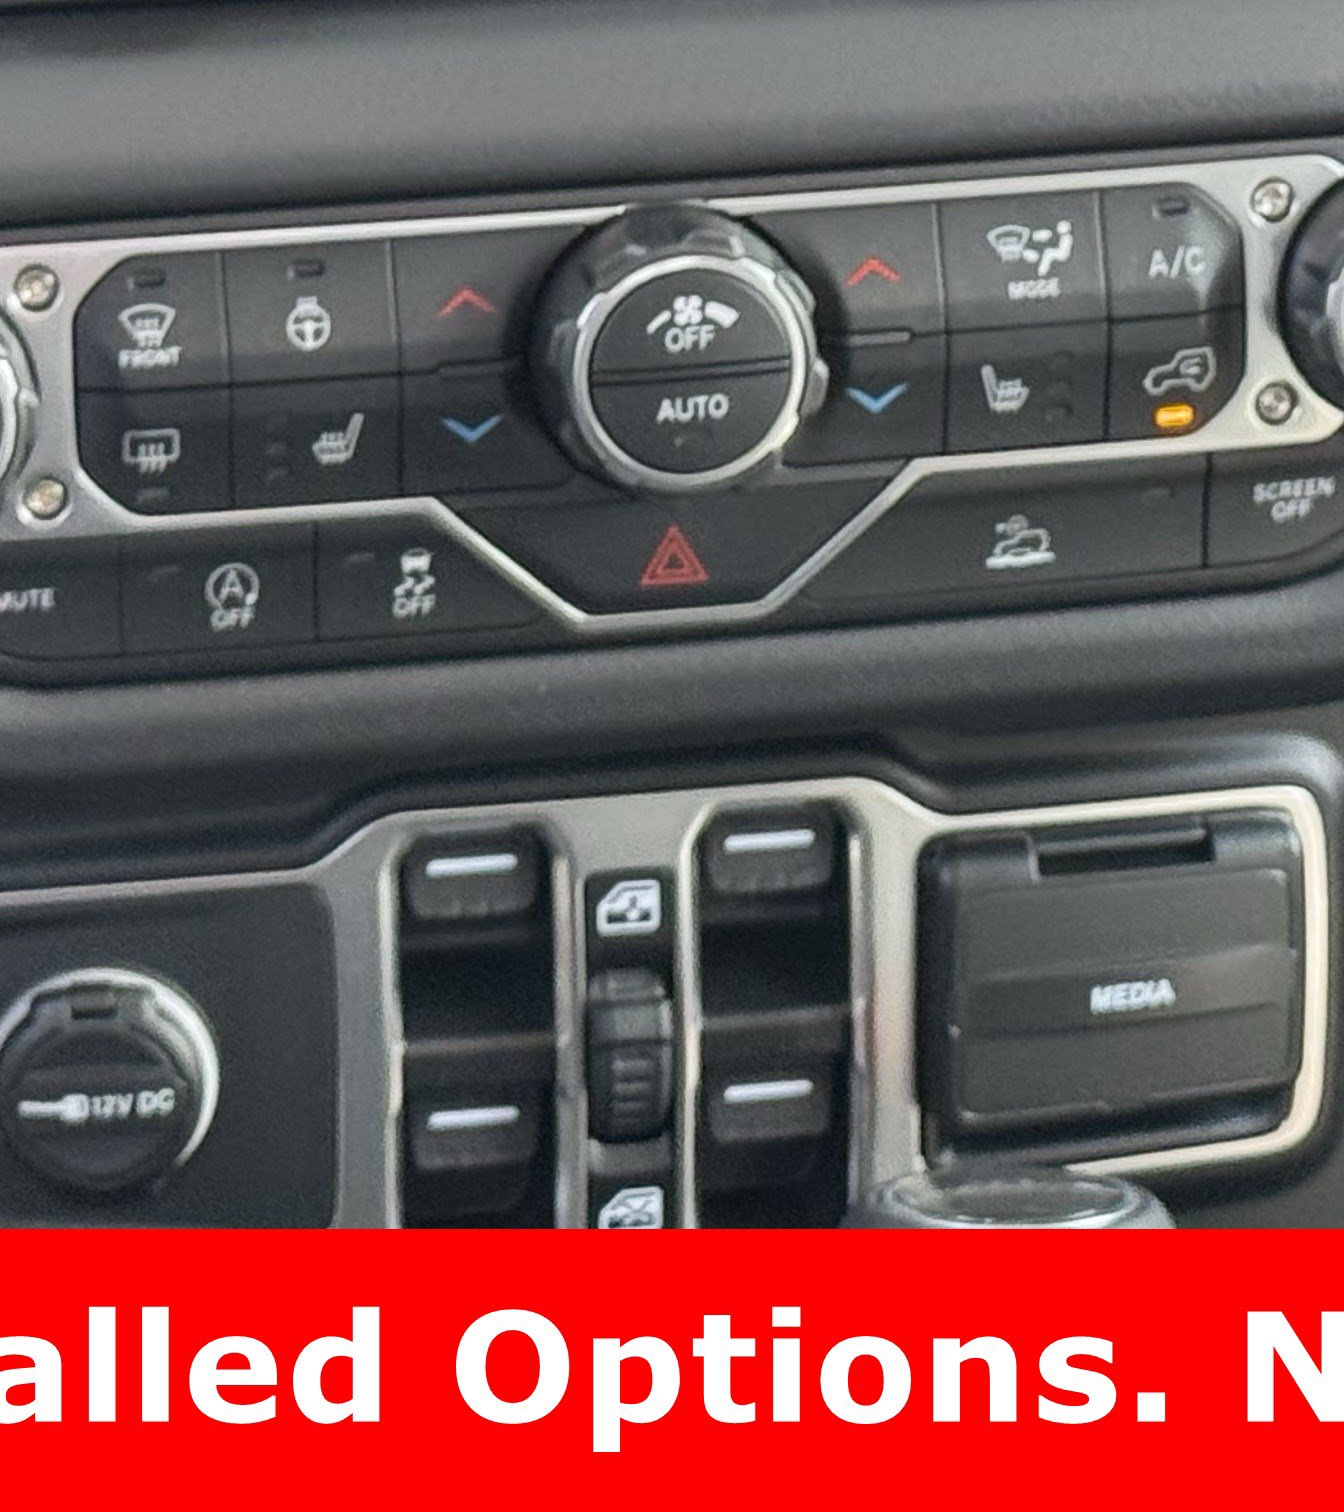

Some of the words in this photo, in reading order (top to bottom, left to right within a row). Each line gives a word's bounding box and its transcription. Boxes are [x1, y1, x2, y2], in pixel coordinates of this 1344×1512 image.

[1148, 244, 1206, 278] A/C
[665, 325, 717, 354] OFF
[118, 347, 183, 370] FRONT
[656, 394, 729, 423] AUTO
[1254, 476, 1336, 504] SCREEN
[1271, 499, 1314, 523] OFF
[210, 607, 257, 634] OFF
[392, 593, 438, 620] OFF
[1090, 978, 1177, 1015] MEDIA
